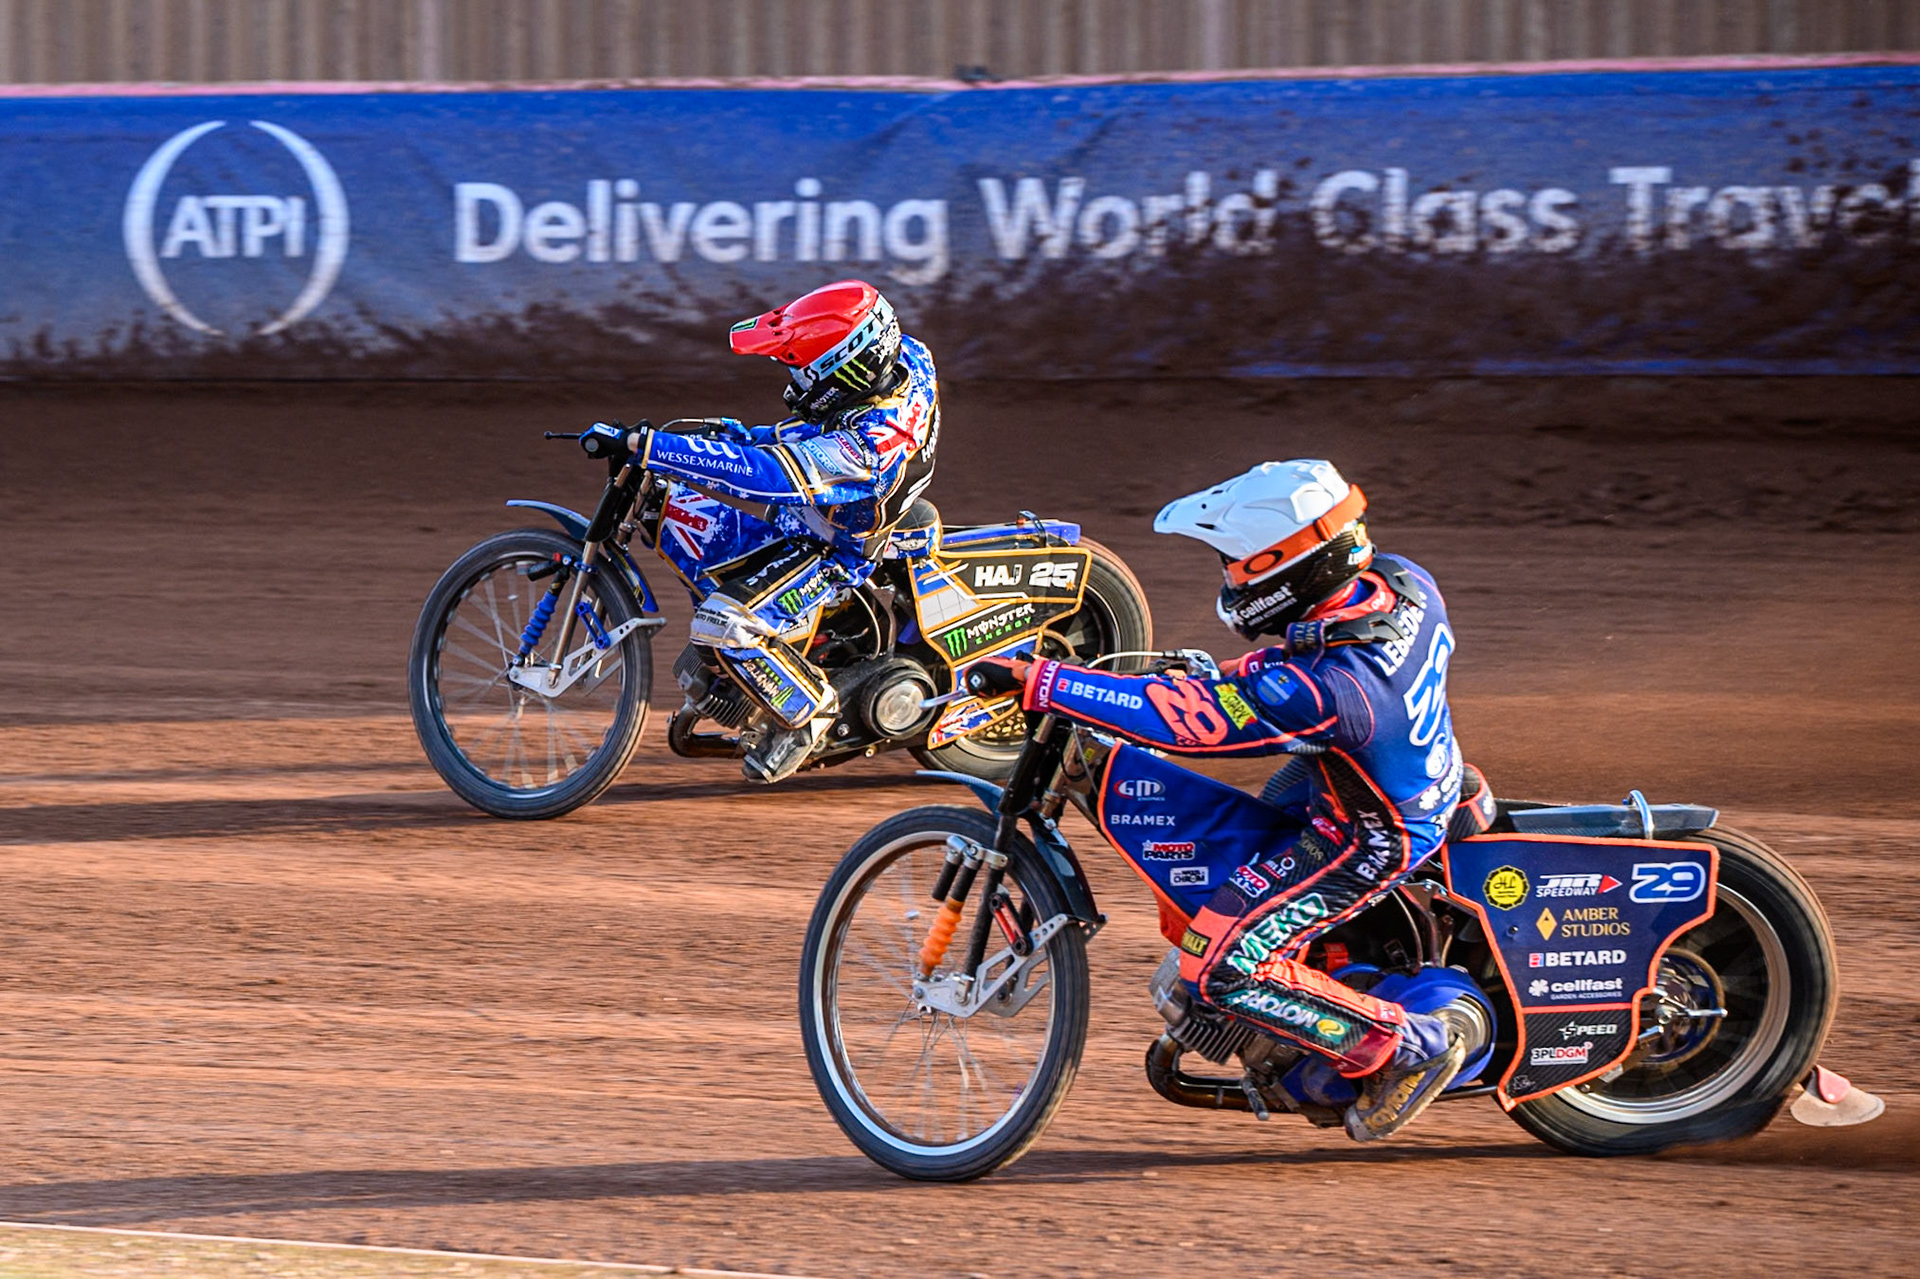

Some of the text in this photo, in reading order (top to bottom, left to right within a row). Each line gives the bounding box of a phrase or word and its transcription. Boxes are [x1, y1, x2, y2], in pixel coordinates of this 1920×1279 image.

[161, 195, 305, 260] ATPI
[455, 178, 948, 286] Delivering
[979, 168, 1278, 260] World
[1310, 166, 1580, 254] Class
[819, 309, 886, 375] SCOTT
[656, 449, 753, 477] WESSEXMARINE
[1028, 561, 1079, 588] 25
[1240, 585, 1293, 619] cellfast
[966, 602, 1036, 639] MONSTER
[975, 616, 1033, 646] ENERGY
[1070, 681, 1144, 711] BETARD
[1117, 779, 1162, 798] GM
[1111, 814, 1176, 827] BRAMEX
[1143, 850, 1194, 860] PARTS
[1153, 842, 1195, 852] MOTO
[1535, 886, 1599, 898] SPEEDWAY
[1629, 861, 1706, 904] 29
[1562, 907, 1619, 921] AMBER
[1561, 921, 1631, 938] STUDIOS
[1545, 949, 1627, 967] BETARD
[1550, 977, 1624, 993] cellfast
[1560, 1022, 1618, 1040] SPEED
[1531, 1048, 1588, 1061] 3PLDGM
